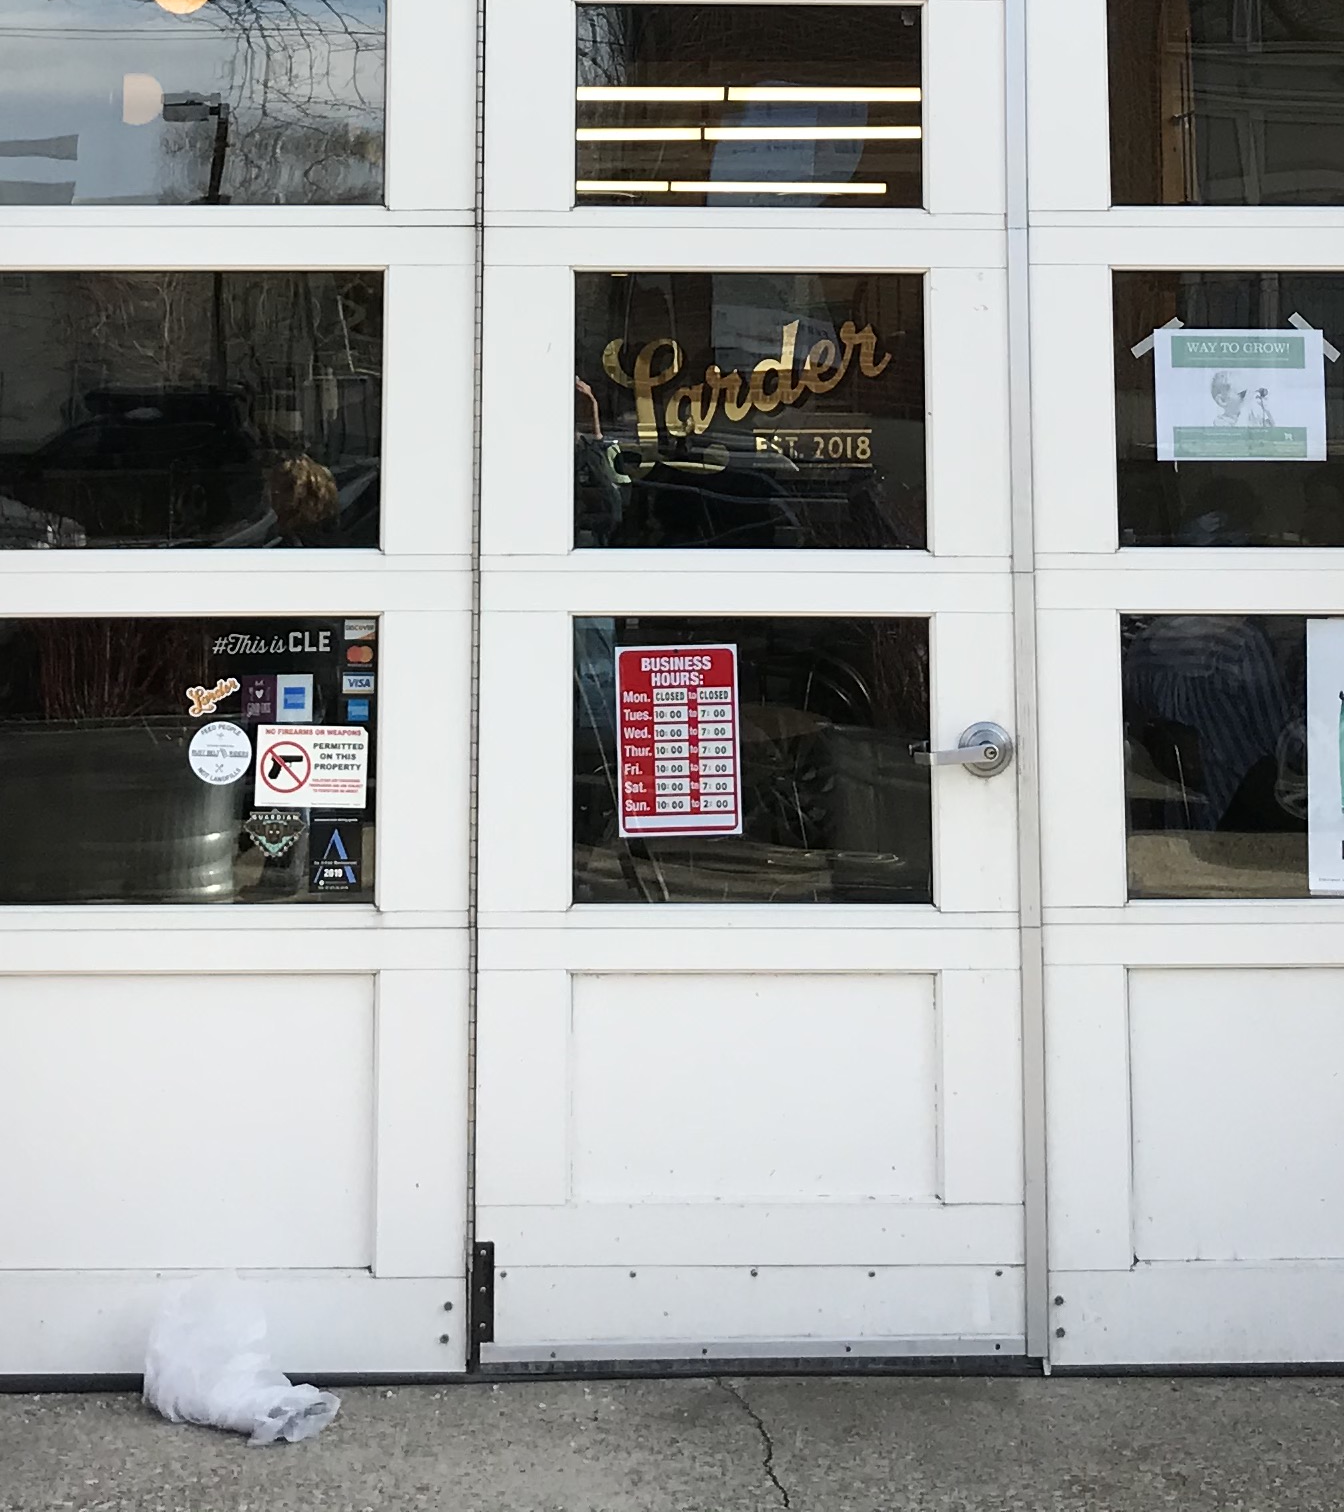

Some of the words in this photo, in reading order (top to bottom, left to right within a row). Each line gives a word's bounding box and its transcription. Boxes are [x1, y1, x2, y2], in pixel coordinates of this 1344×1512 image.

[1186, 341, 1218, 354] WAY
[1220, 341, 1240, 354] TO
[1243, 341, 1290, 355] GROW!
[602, 319, 892, 477] Larder
[755, 436, 804, 459] EST.
[813, 436, 871, 460] 2018
[288, 631, 331, 653] CLE
[641, 656, 712, 671] BUSINESS
[347, 678, 371, 688] VISA
[651, 672, 704, 687] HOURS:
[623, 690, 651, 703] Mon.
[655, 691, 685, 702] CLOSED
[688, 691, 697, 700] to
[699, 690, 729, 700] CLOSED
[623, 709, 652, 721] Tues.
[689, 709, 697, 718] to
[201, 724, 217, 735] FEED
[218, 724, 242, 736] PEOPLE
[277, 728, 313, 736] FIREARMS
[624, 727, 651, 739] Wed.
[689, 727, 698, 736] to
[313, 742, 364, 751] PERMITTED
[624, 745, 652, 757] Thur.
[690, 744, 699, 754] to
[335, 753, 357, 761] THIS
[314, 763, 362, 771] PROPERTY
[624, 763, 643, 775] Fri.
[690, 763, 699, 772] to
[198, 767, 210, 779] NOT
[209, 767, 241, 782] LANDFILLS
[624, 781, 648, 794] Sat.
[690, 781, 699, 790] to
[625, 799, 650, 812] Sun.
[691, 799, 700, 808] to
[323, 868, 343, 878] 2019
